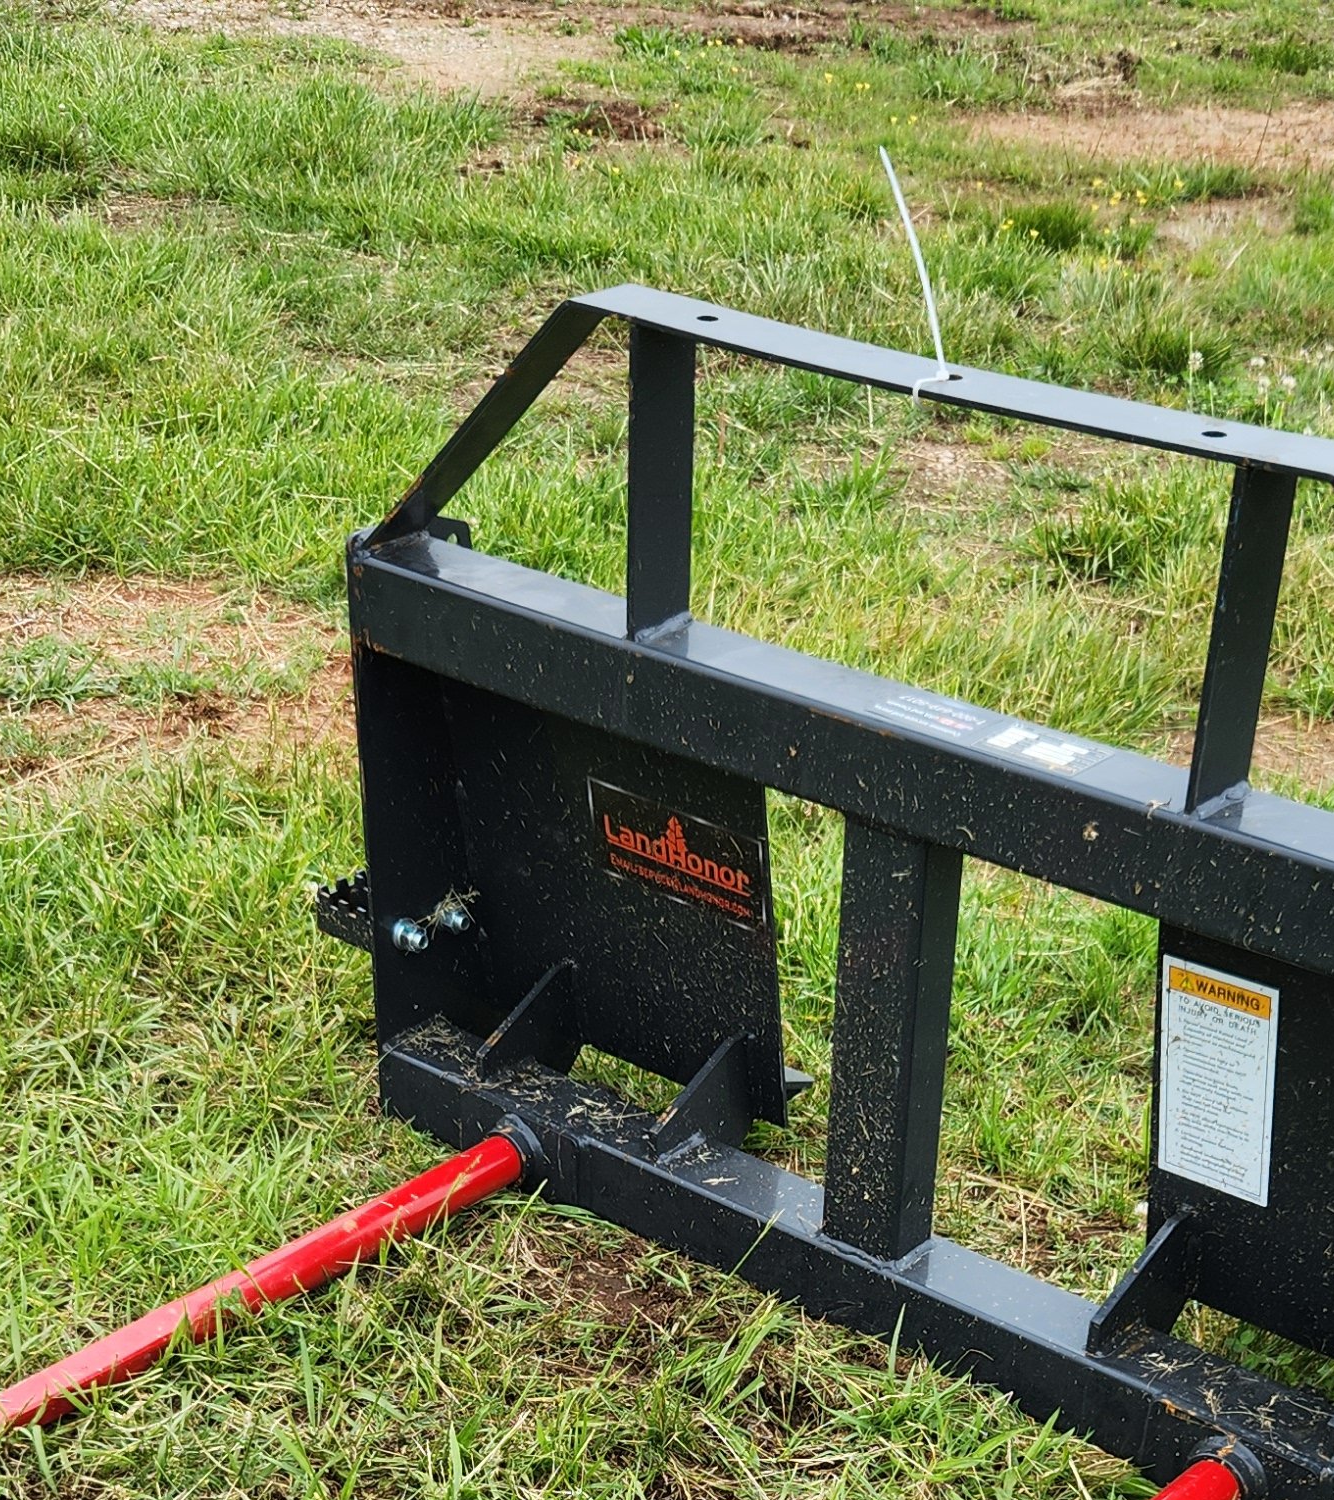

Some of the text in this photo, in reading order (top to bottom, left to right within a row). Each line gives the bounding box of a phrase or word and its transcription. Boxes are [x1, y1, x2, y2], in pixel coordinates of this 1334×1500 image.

[603, 814, 750, 892] LandHonor
[1195, 979, 1260, 1011] WARNING
[1178, 995, 1260, 1028] TO AVOID SERIOUS
[1178, 1005, 1256, 1036] INJURY OR DEATH
